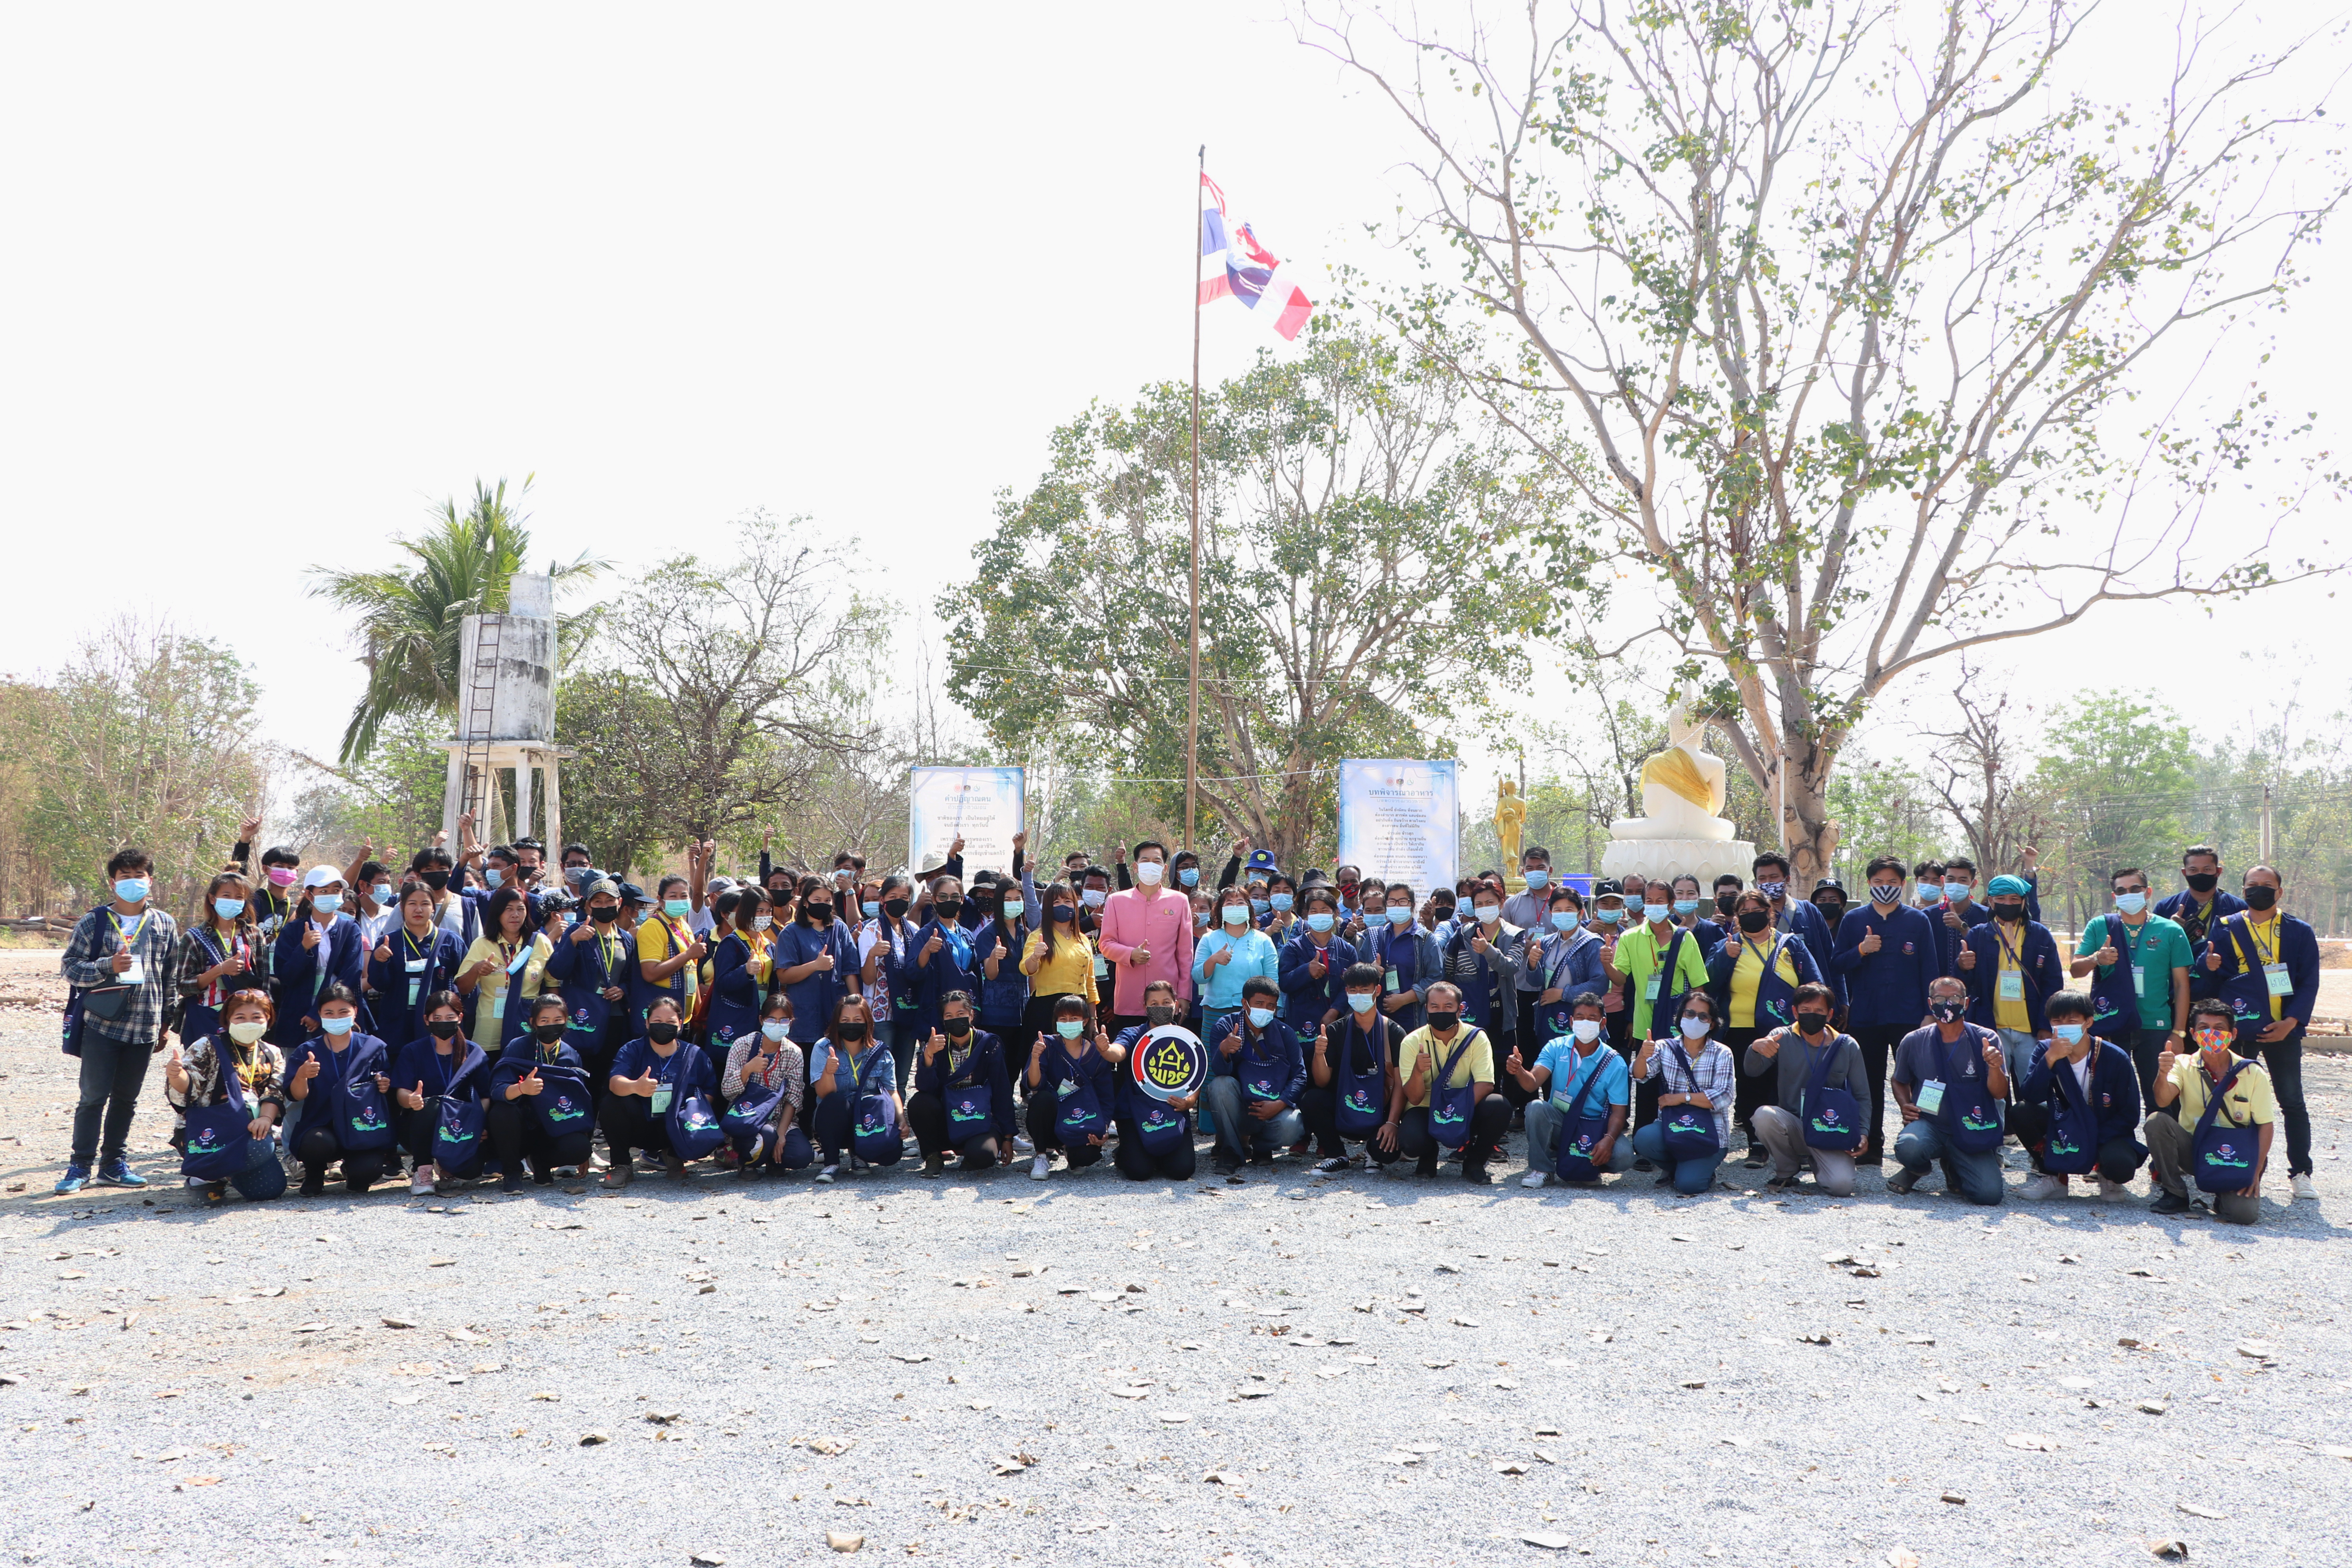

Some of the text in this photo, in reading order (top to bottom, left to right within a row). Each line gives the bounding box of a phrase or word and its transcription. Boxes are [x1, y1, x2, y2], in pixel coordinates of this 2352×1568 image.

[1368, 788, 1433, 796] บทพิจารณาอาหาร
[945, 794, 991, 803] คำปฏิญาณตน
[592, 882, 612, 891] GUCCI
[262, 926, 274, 935] PPL
